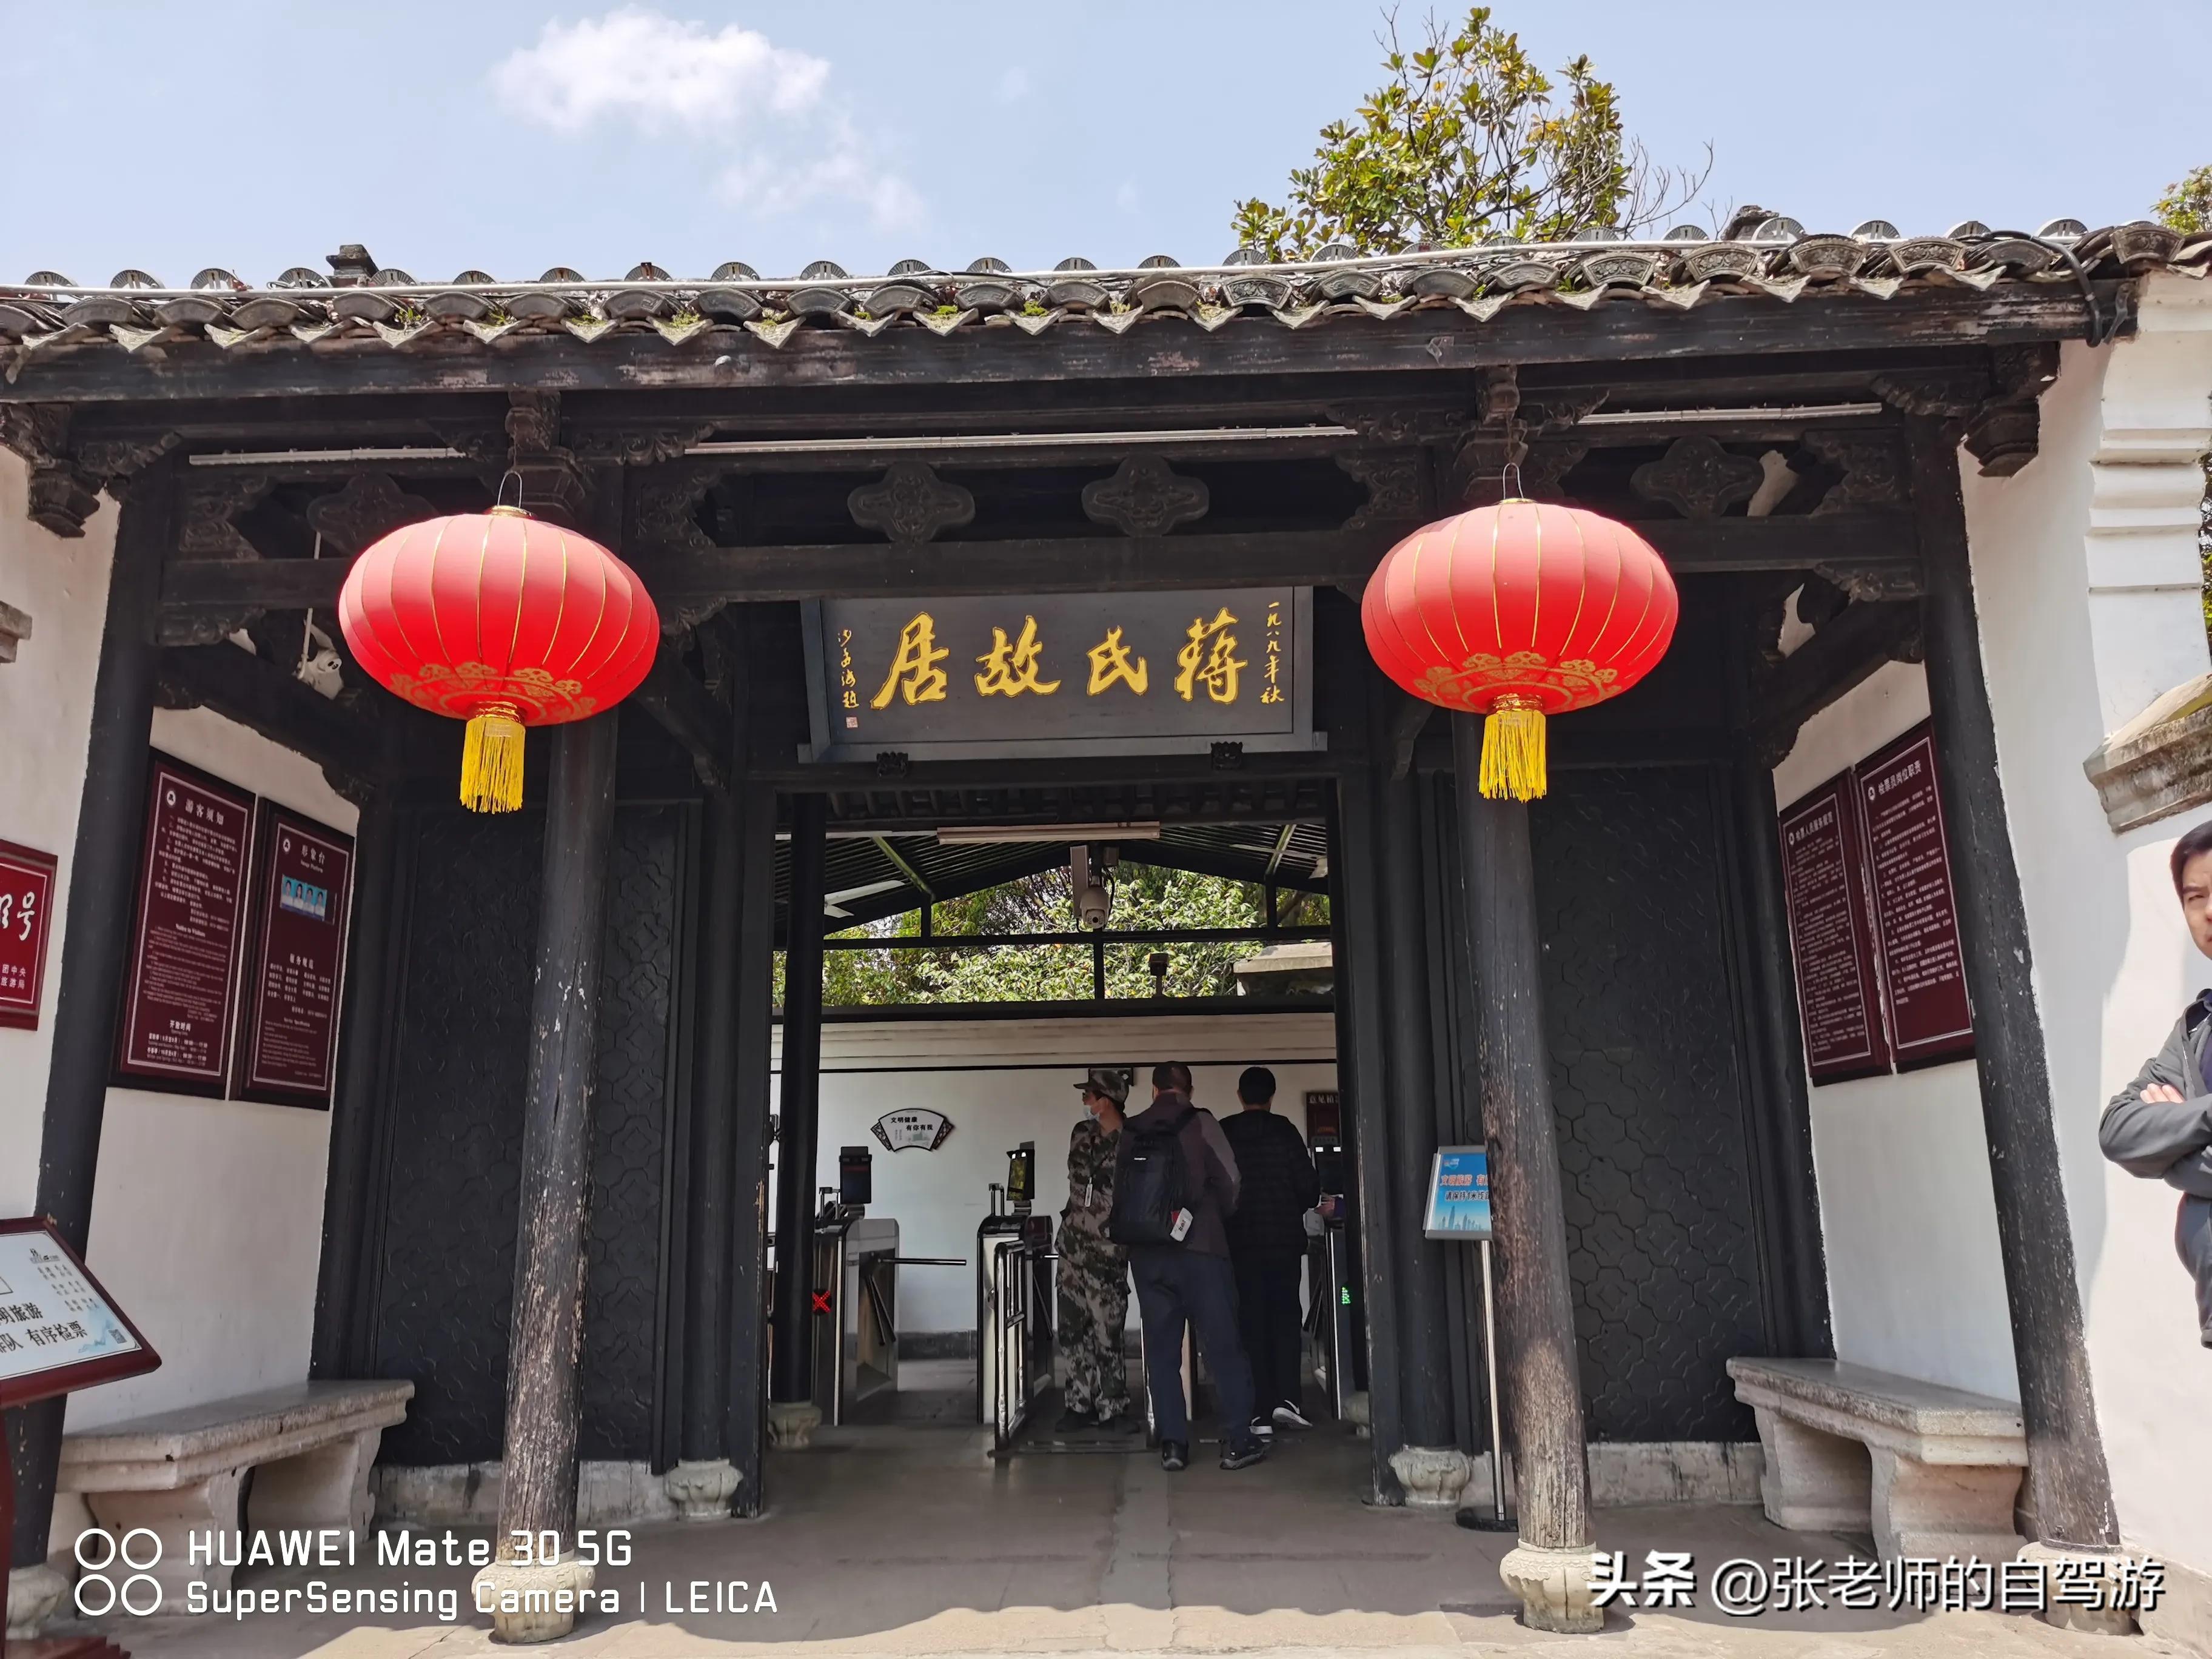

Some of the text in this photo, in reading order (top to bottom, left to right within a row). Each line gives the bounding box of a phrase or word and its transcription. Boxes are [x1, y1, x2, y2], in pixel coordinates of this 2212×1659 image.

[870, 606, 1248, 710] 蒋氏故居
[1879, 760, 1921, 795] 检票员岗位职责
[186, 798, 224, 825] 游客须知
[2, 964, 26, 977] 团中央
[290, 953, 313, 969] 服务规范
[1, 976, 25, 990] 旅游局
[170, 1020, 191, 1032] 开放时间
[26, 1320, 87, 1346] 有序检票
